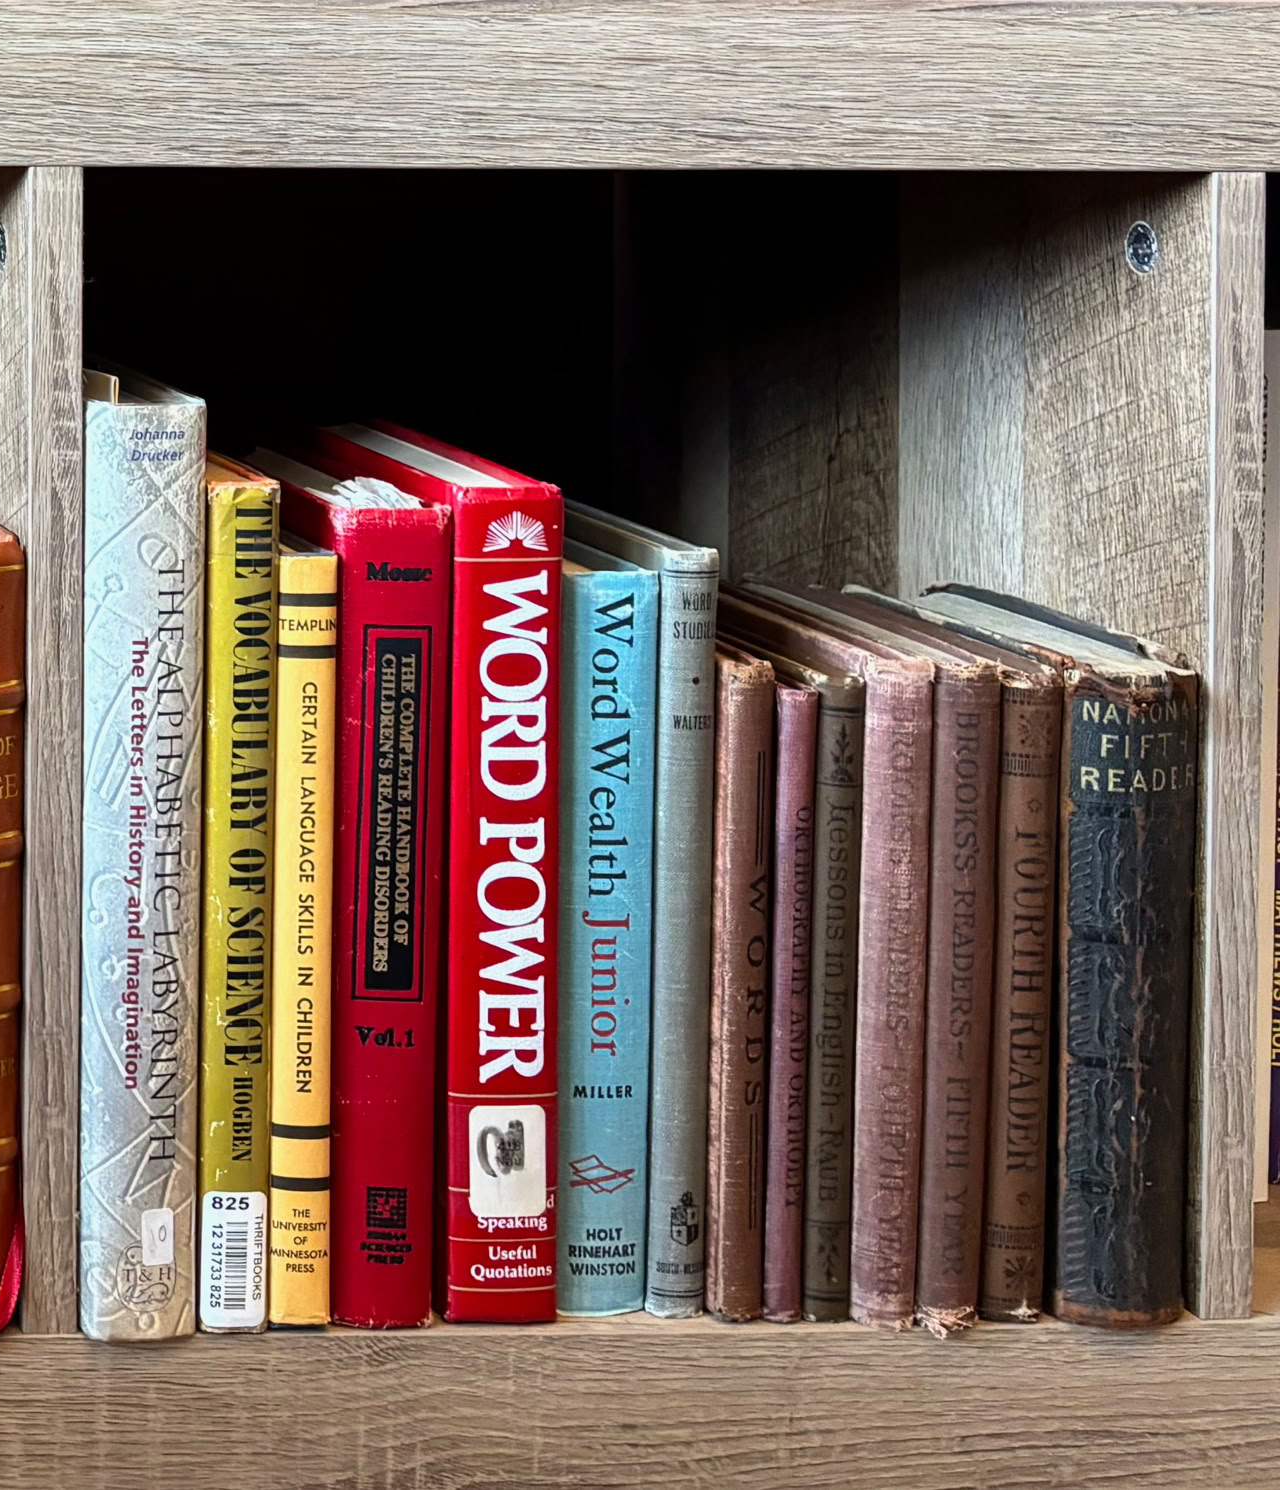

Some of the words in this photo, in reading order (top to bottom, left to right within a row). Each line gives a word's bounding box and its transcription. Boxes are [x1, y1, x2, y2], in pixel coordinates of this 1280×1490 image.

[129, 428, 185, 442] Johanna
[131, 449, 184, 462] Drucker
[279, 617, 337, 632] TEMPLIN
[682, 592, 712, 610] WORD
[479, 570, 549, 801] WORD
[591, 593, 635, 722] Word
[130, 685, 149, 769] Letters
[229, 592, 272, 837] VOCABULARY
[301, 681, 318, 764] CERTAIN
[154, 655, 184, 912] ALPHABETIC
[588, 729, 631, 898] Wealth
[300, 778, 317, 895] LANGUAGE
[297, 892, 315, 956] SKILLS
[373, 898, 390, 972] DISORDERS
[476, 817, 546, 1083] POWER
[122, 948, 145, 1090] Imagination
[223, 906, 267, 1067] SCIENCE
[582, 910, 630, 1056] Junior
[745, 874, 767, 1110] WORDS
[148, 924, 181, 1163] LABYRINTH
[295, 997, 313, 1094] CHILDREN
[789, 1011, 805, 1062] AND
[229, 1076, 253, 1163] HOGBEN
[573, 1085, 633, 1098] MILLER
[1006, 1009, 1047, 1174] READER
[211, 1196, 249, 1211] 825
[272, 1220, 328, 1232] UNIVERSITY
[477, 1215, 548, 1233] Speaking
[586, 1228, 622, 1241] HOLT
[252, 1213, 264, 1300] THRIFTBOOKS
[270, 1246, 328, 1259] MINNESOTA
[285, 1262, 315, 1273] PRESS
[471, 1263, 552, 1281] Quotations
[488, 1245, 537, 1261] Useful
[569, 1245, 636, 1258] RINEHART
[571, 1262, 636, 1275] WINSTON
